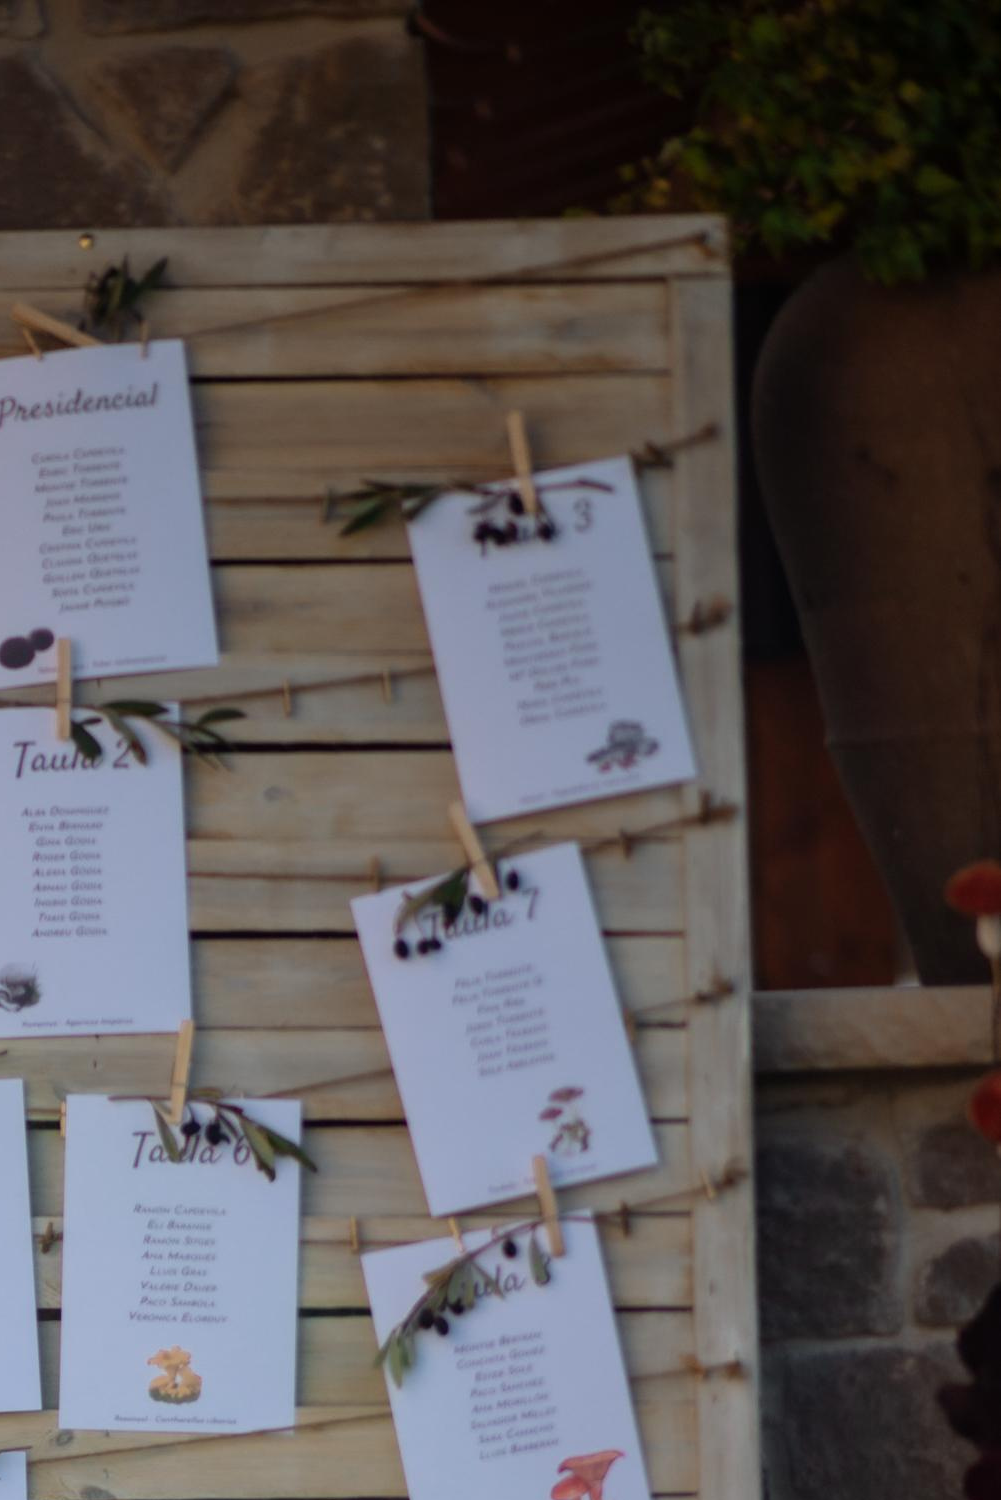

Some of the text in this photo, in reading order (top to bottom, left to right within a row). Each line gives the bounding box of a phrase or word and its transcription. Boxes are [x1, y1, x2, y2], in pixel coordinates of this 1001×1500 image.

[573, 498, 594, 532] 3
[113, 738, 132, 770] 2
[523, 888, 540, 919] 7
[131, 1131, 251, 1169] Tala 6
